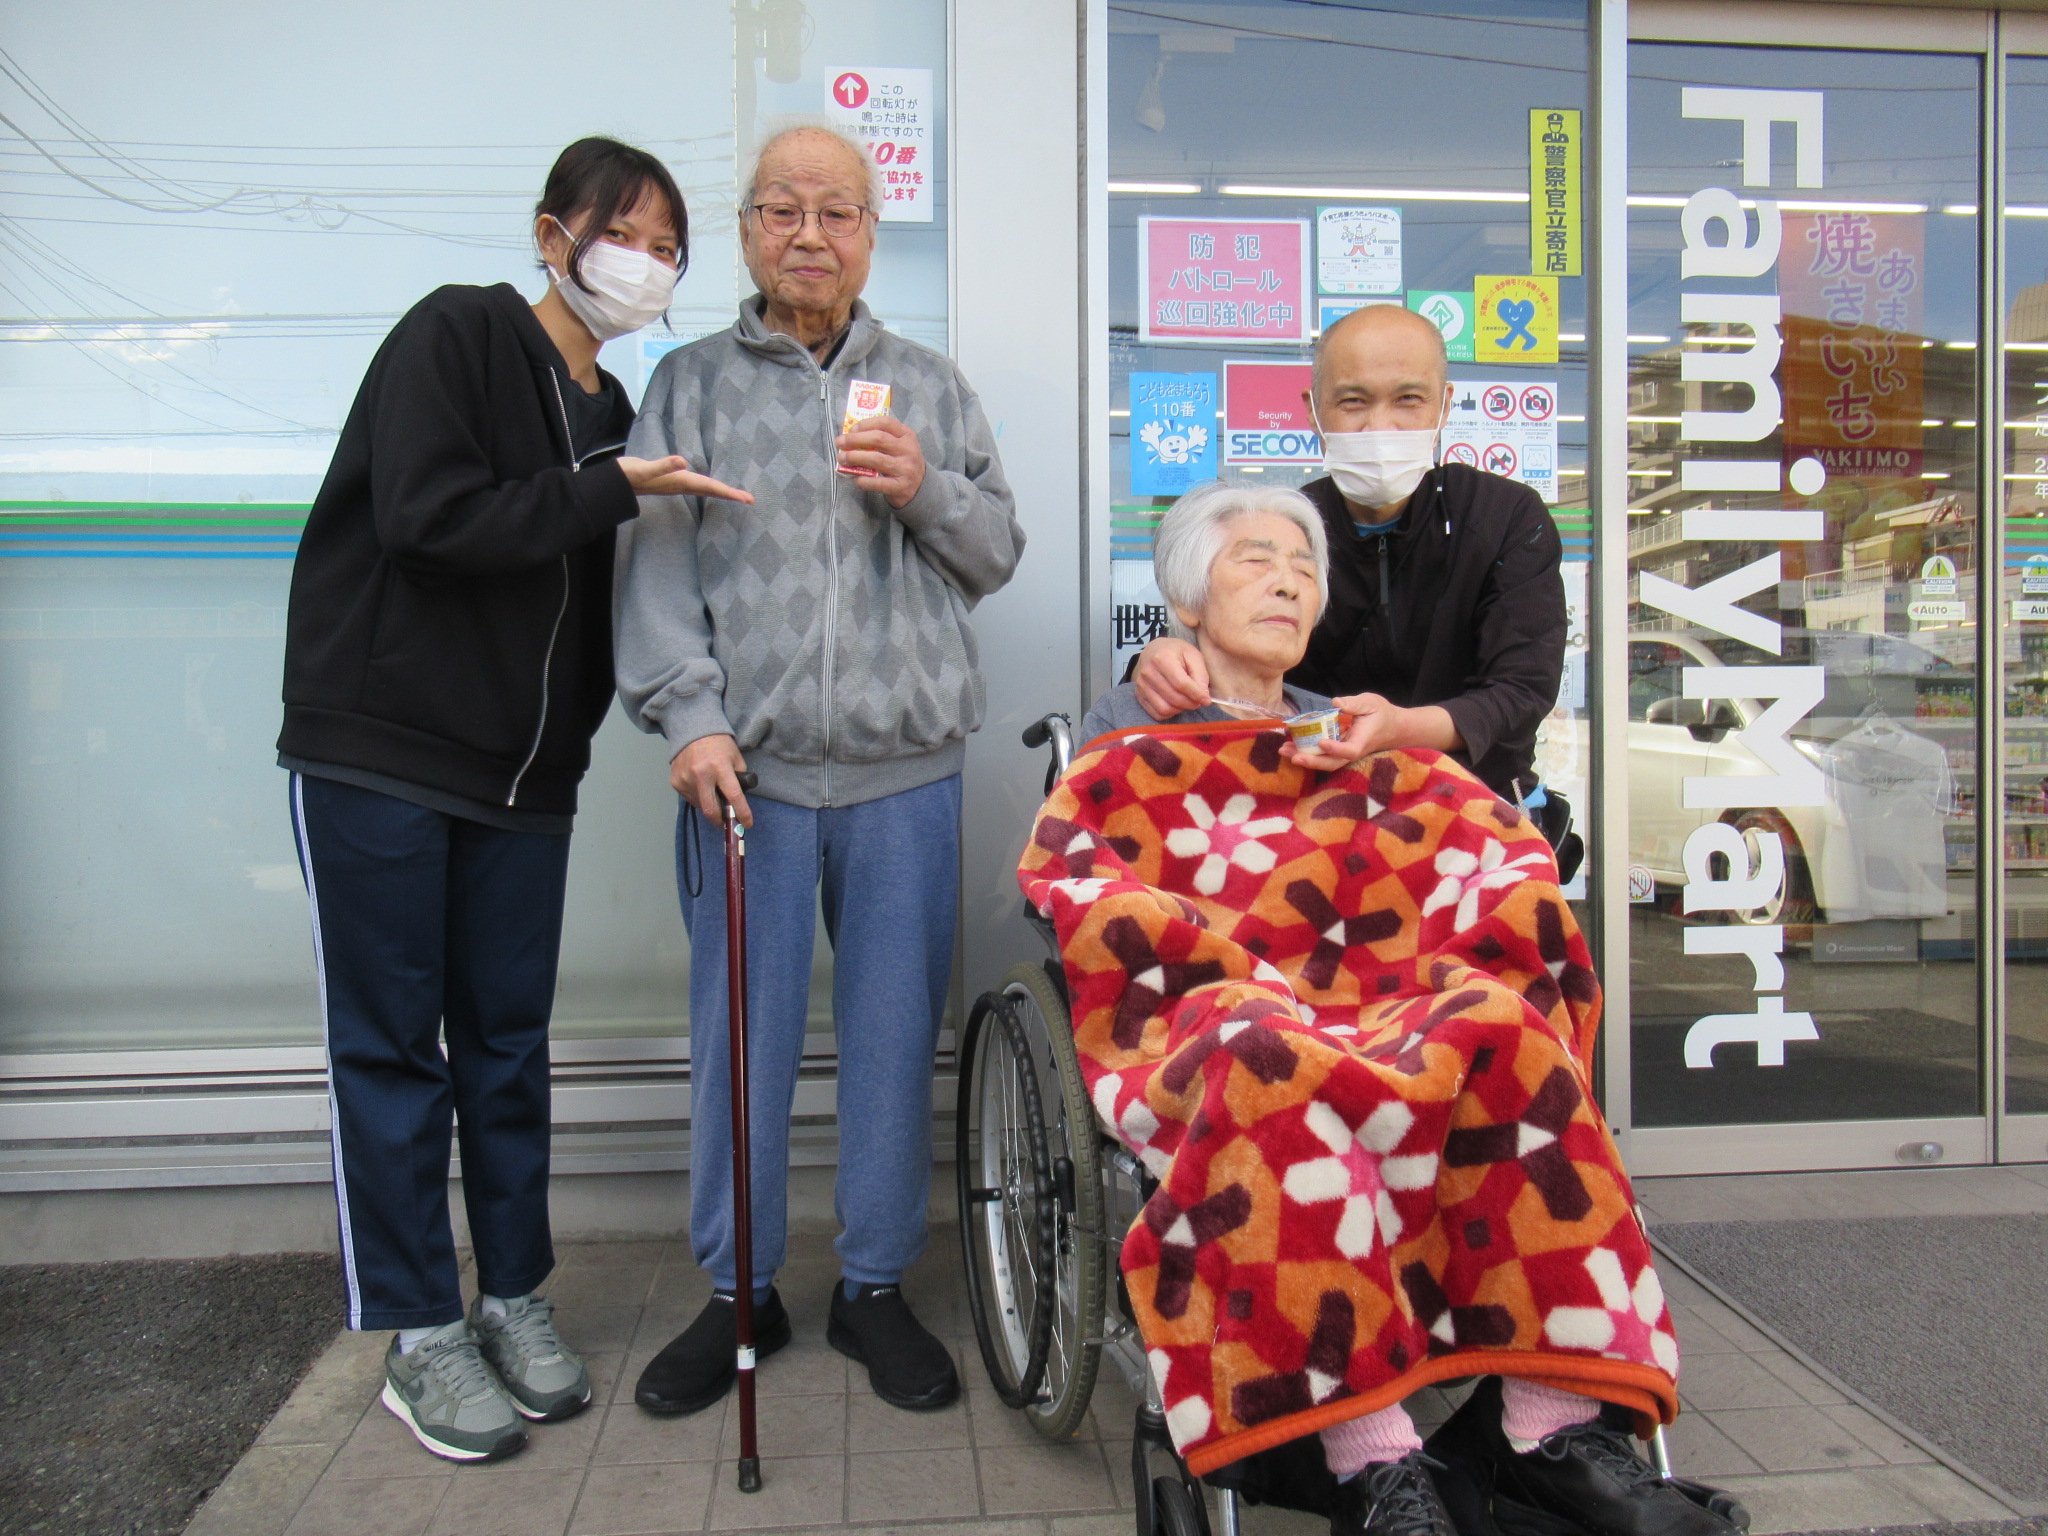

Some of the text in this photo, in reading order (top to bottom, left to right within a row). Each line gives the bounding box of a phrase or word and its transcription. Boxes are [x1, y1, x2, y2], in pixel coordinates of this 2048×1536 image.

[880, 84, 904, 95] この
[870, 97, 918, 110] 回転灯が
[861, 111, 918, 124] 鳴った時は
[1544, 145, 1567, 272] 警察官立寄店
[1168, 266, 1282, 293] パトロール
[1157, 299, 1293, 329] 巡回強化中
[1808, 213, 1877, 442] 焼きいも
[1139, 381, 1211, 406] こどもをまもろう
[1153, 402, 1196, 417] 110番
[1258, 411, 1292, 421] Security
[1270, 420, 1280, 429] by
[1231, 433, 1319, 456] SECOM
[1813, 449, 1910, 467] YAKIIMO
[1640, 87, 1824, 1069] FamilyMart
[1920, 606, 1948, 614] Auto
[2030, 605, 2048, 614] Aut
[424, 1336, 448, 1353] NIKE
